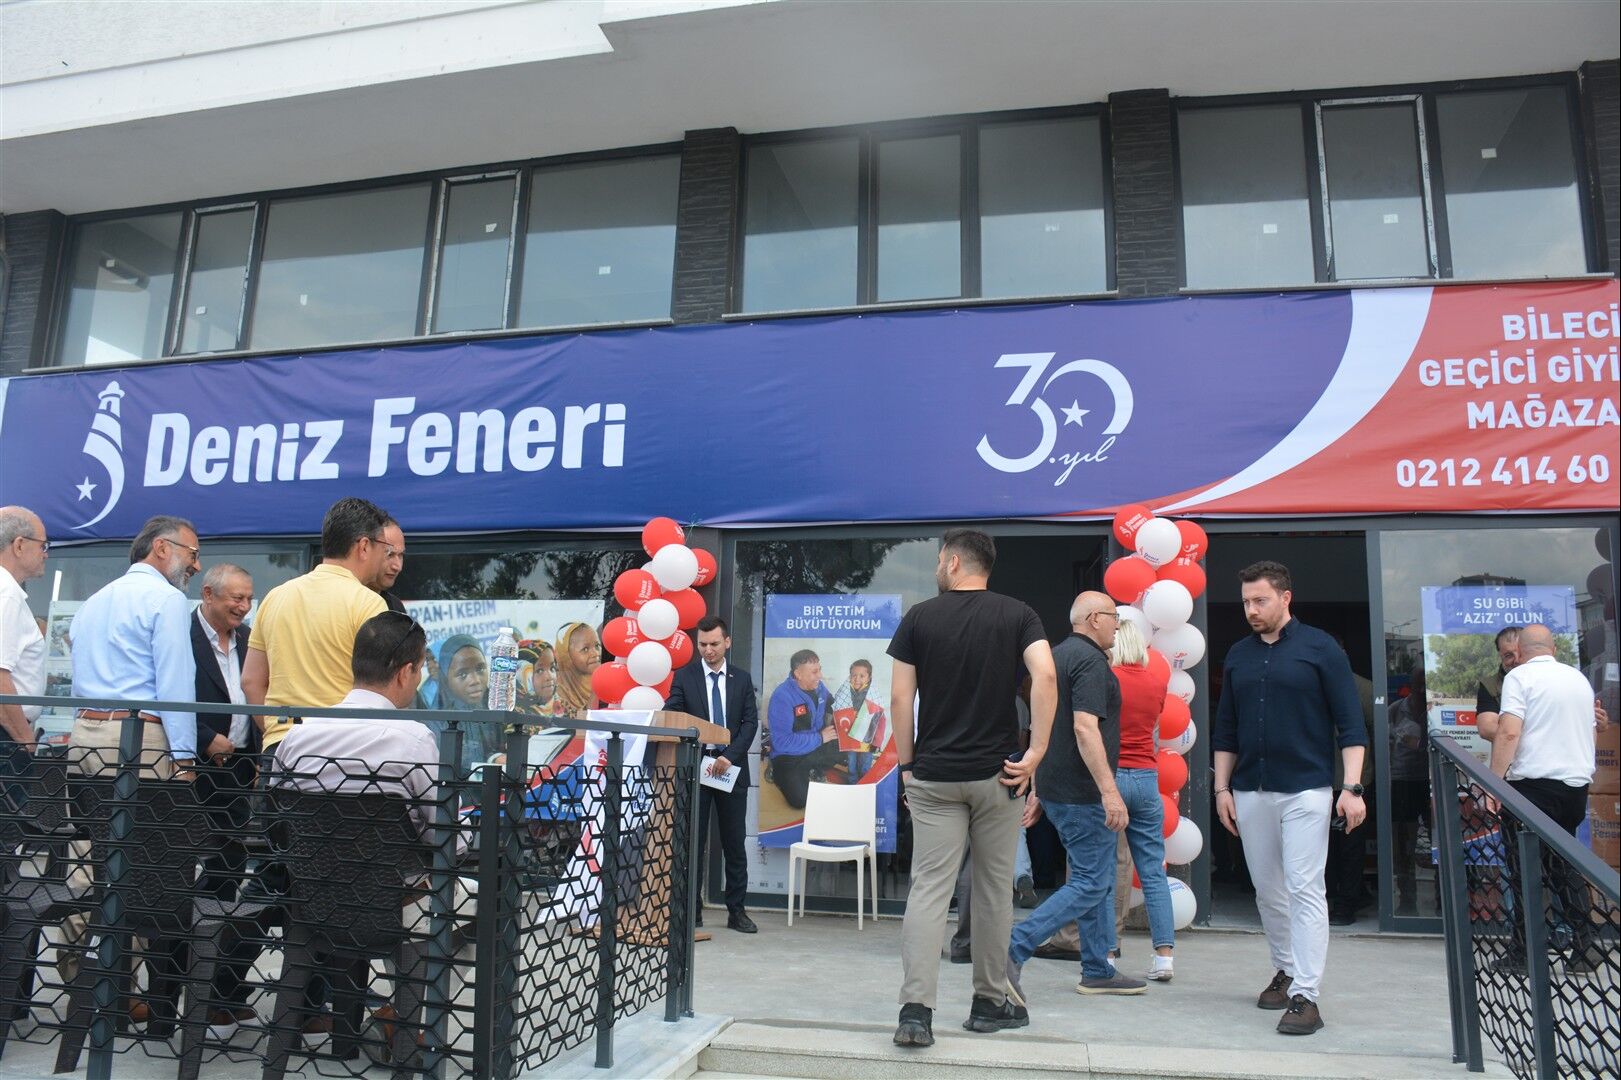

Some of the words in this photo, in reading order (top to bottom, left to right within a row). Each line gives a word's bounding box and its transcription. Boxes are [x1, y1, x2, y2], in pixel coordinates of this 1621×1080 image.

[1502, 303, 1620, 341] BİLECİ
[1419, 349, 1537, 389] GEÇİCİ
[1548, 346, 1620, 383] GİYİ
[1467, 393, 1620, 429] MAĞAZA
[143, 412, 344, 487] Deniz
[367, 396, 626, 477] Feneri
[1396, 458, 1482, 488] 0212
[1491, 455, 1557, 485] 414
[1566, 454, 1610, 484] 60
[803, 605, 824, 616] BİR
[827, 605, 865, 616] YETİM
[1473, 598, 1492, 609] SU
[1496, 598, 1525, 609] GİBİ
[1504, 612, 1543, 624] OLUN
[786, 618, 882, 630] BÜYÜTÜYORUM
